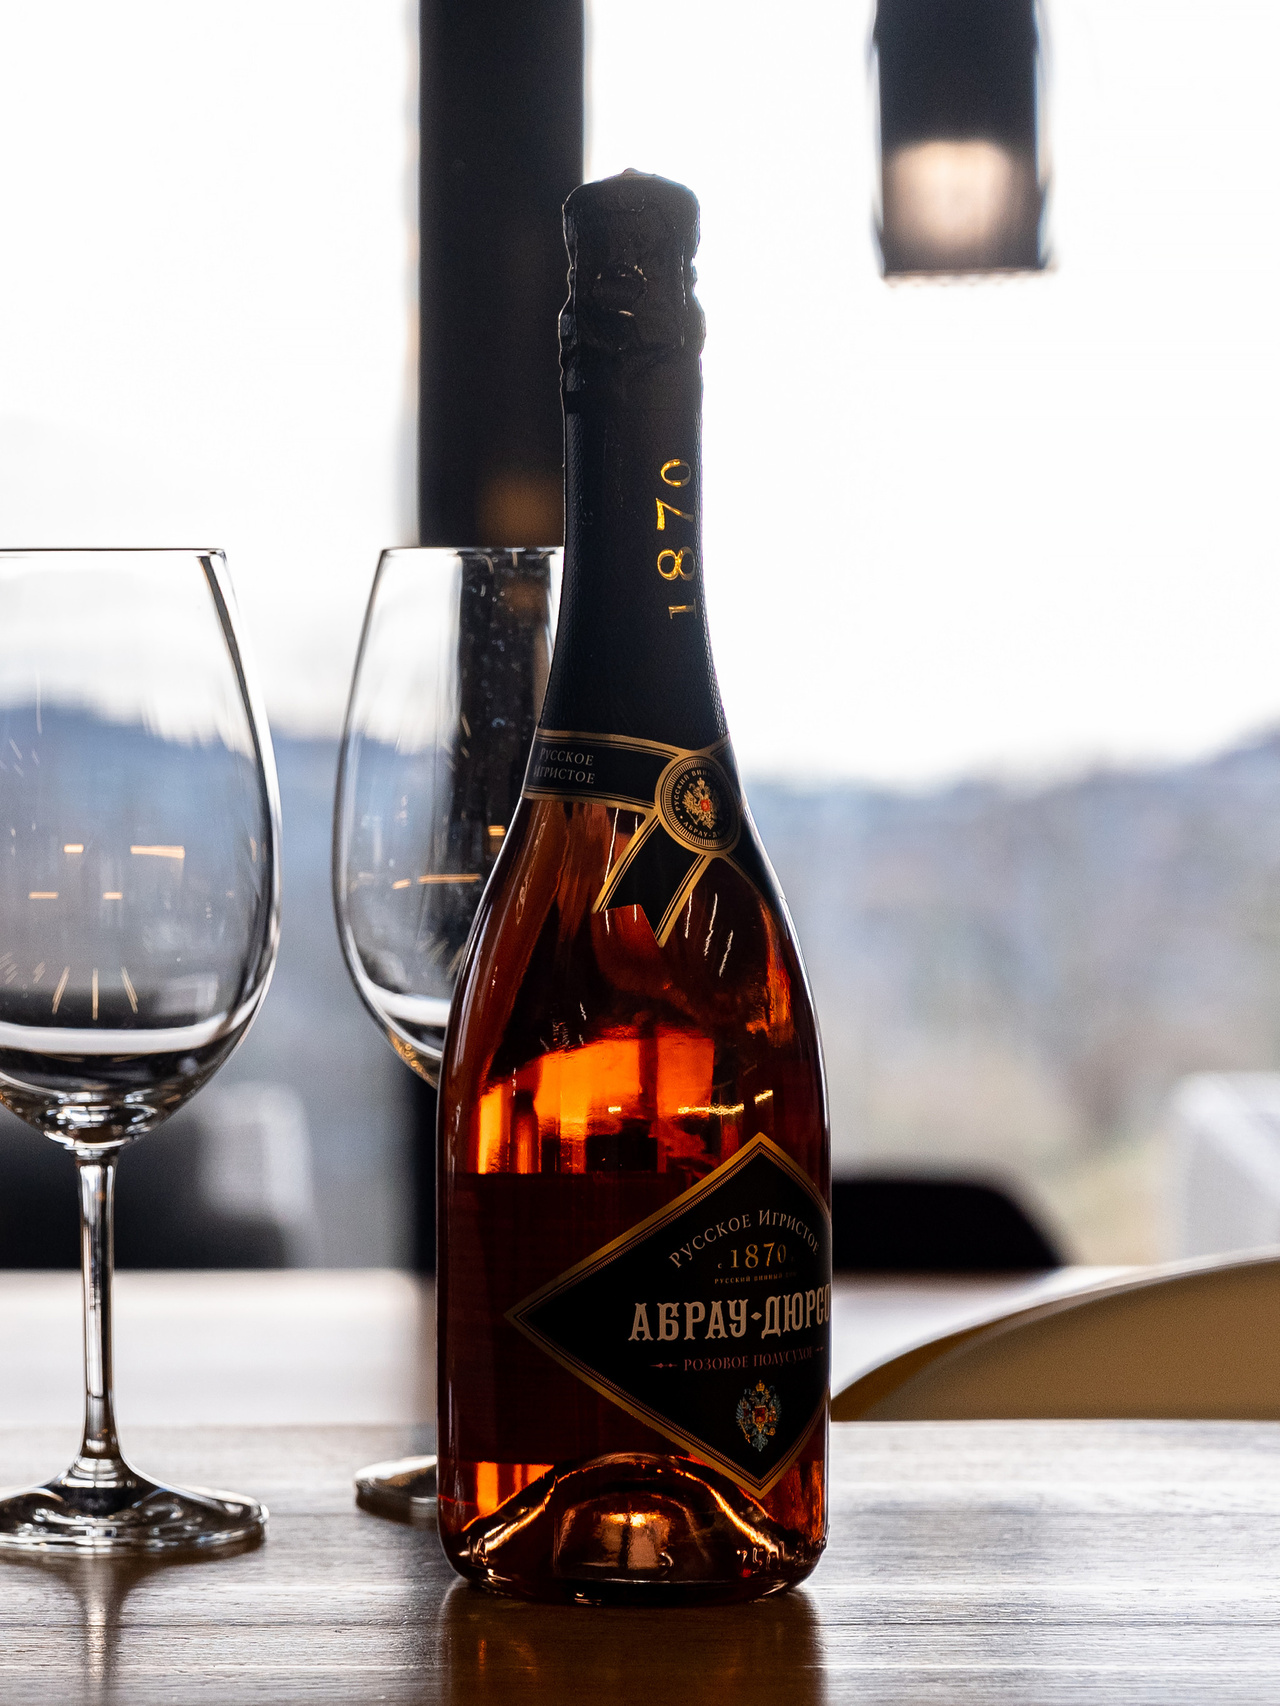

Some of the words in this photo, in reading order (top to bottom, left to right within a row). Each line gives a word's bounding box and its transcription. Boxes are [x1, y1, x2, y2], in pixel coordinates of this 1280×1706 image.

[655, 458, 698, 619] 1870
[539, 747, 594, 767] РУССКОЕ
[533, 764, 596, 785] ИГРИСТОЕ
[668, 1213, 752, 1269] РУССКОЕ
[758, 1208, 820, 1256] ИГРИСТОЕ
[730, 1241, 787, 1269] 1870
[714, 1274, 751, 1286] РУССКИЙ
[683, 1354, 750, 1373] РОЗОВОЕ
